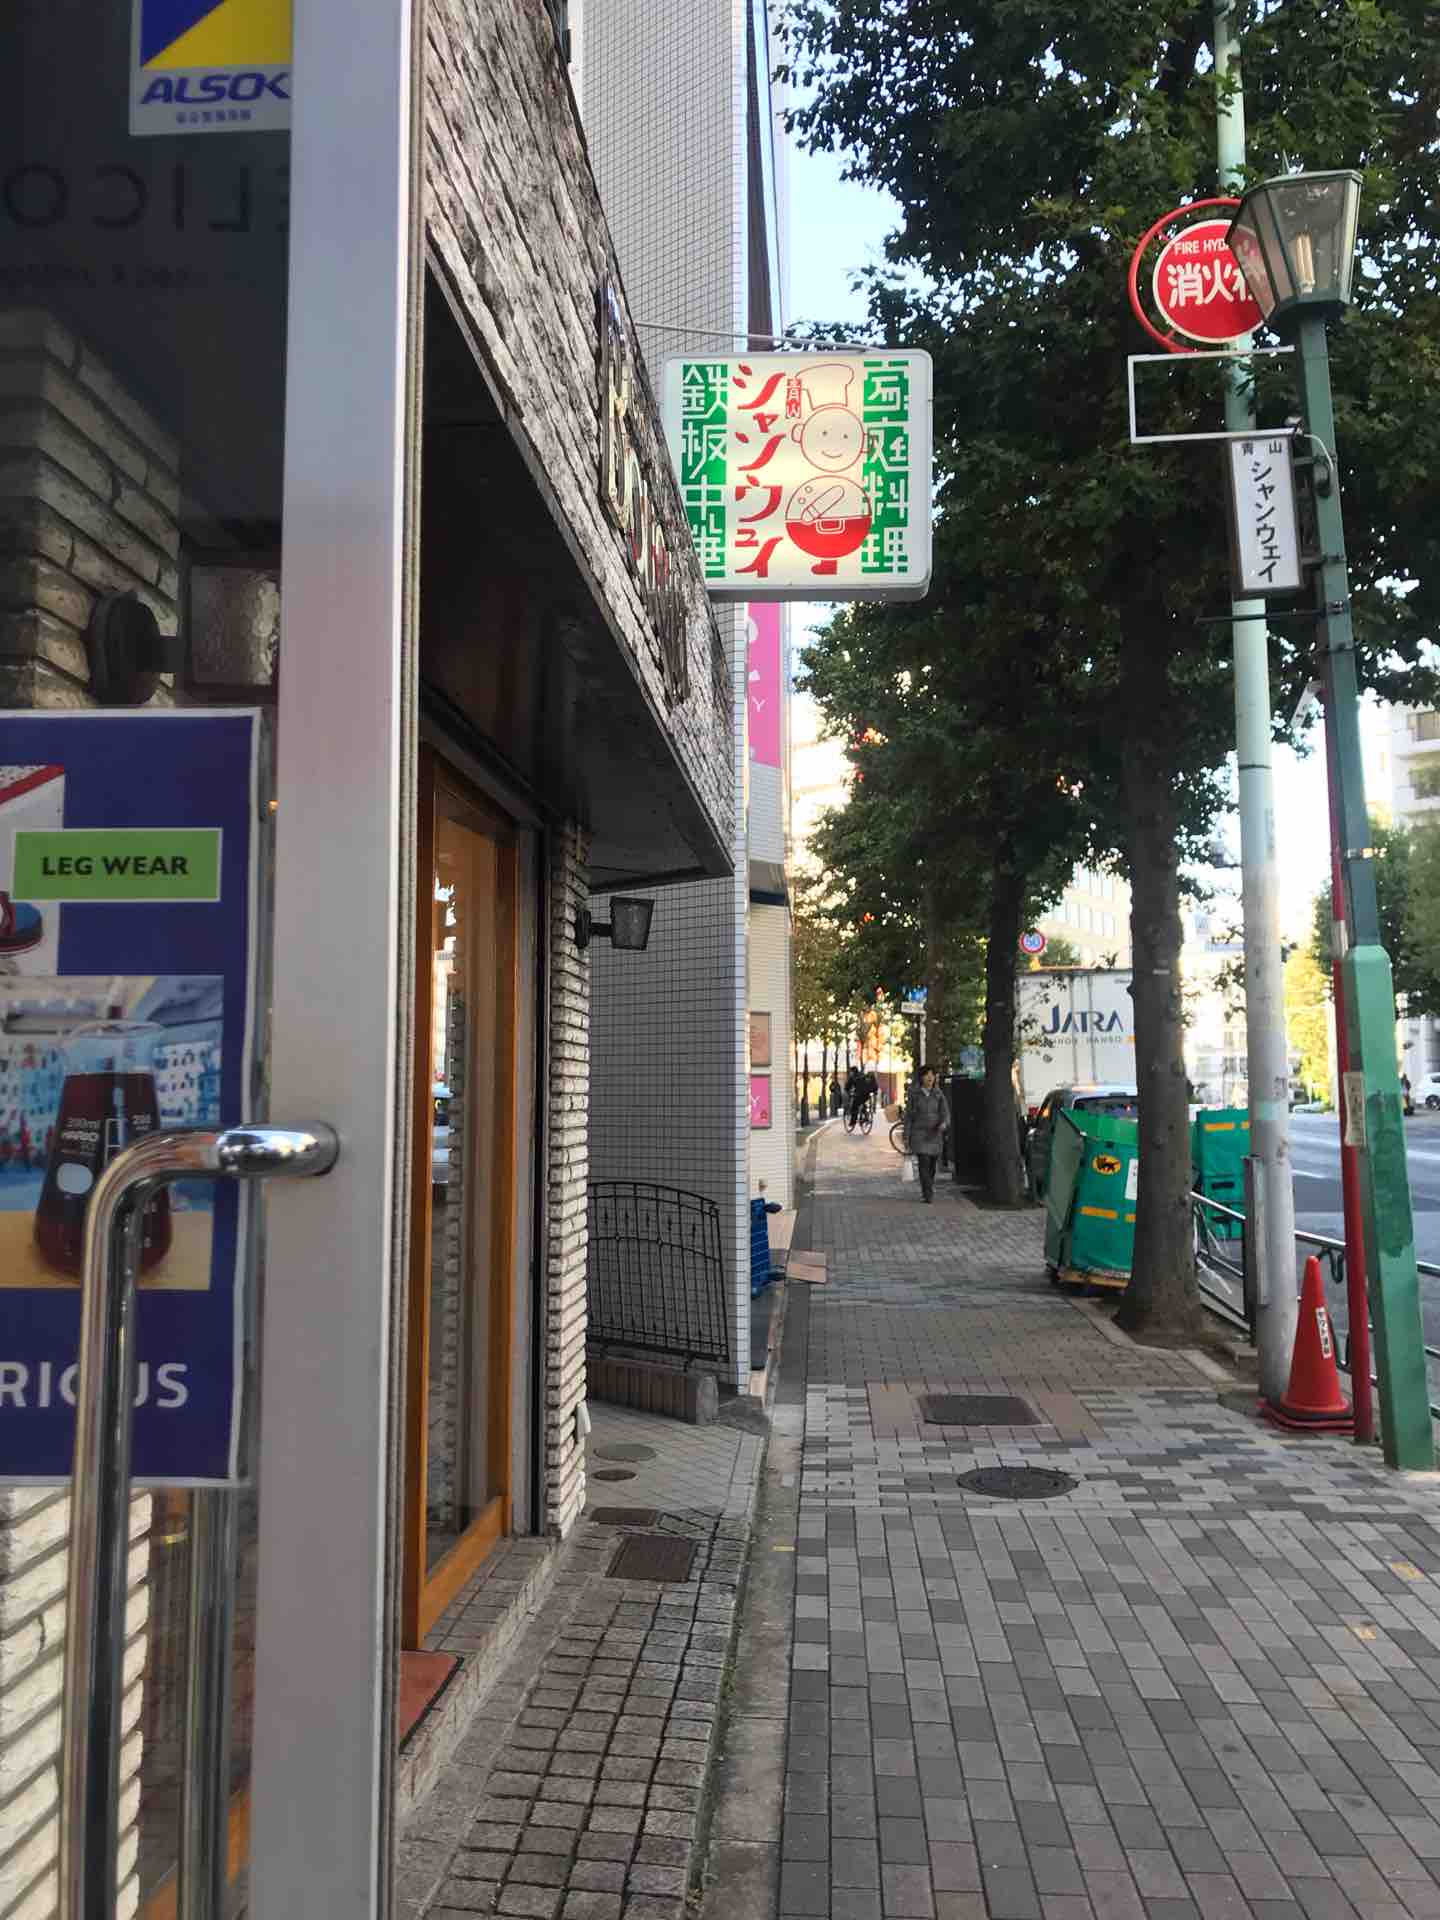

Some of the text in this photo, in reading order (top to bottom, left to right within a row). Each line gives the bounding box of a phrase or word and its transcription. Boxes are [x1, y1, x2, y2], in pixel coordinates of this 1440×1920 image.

[140, 71, 291, 105] ALSOK
[1173, 240, 1200, 255] FIRE
[1241, 439, 1282, 455] 青山
[1251, 460, 1281, 583] シャンウェイ
[42, 855, 189, 876] LEG WEAR
